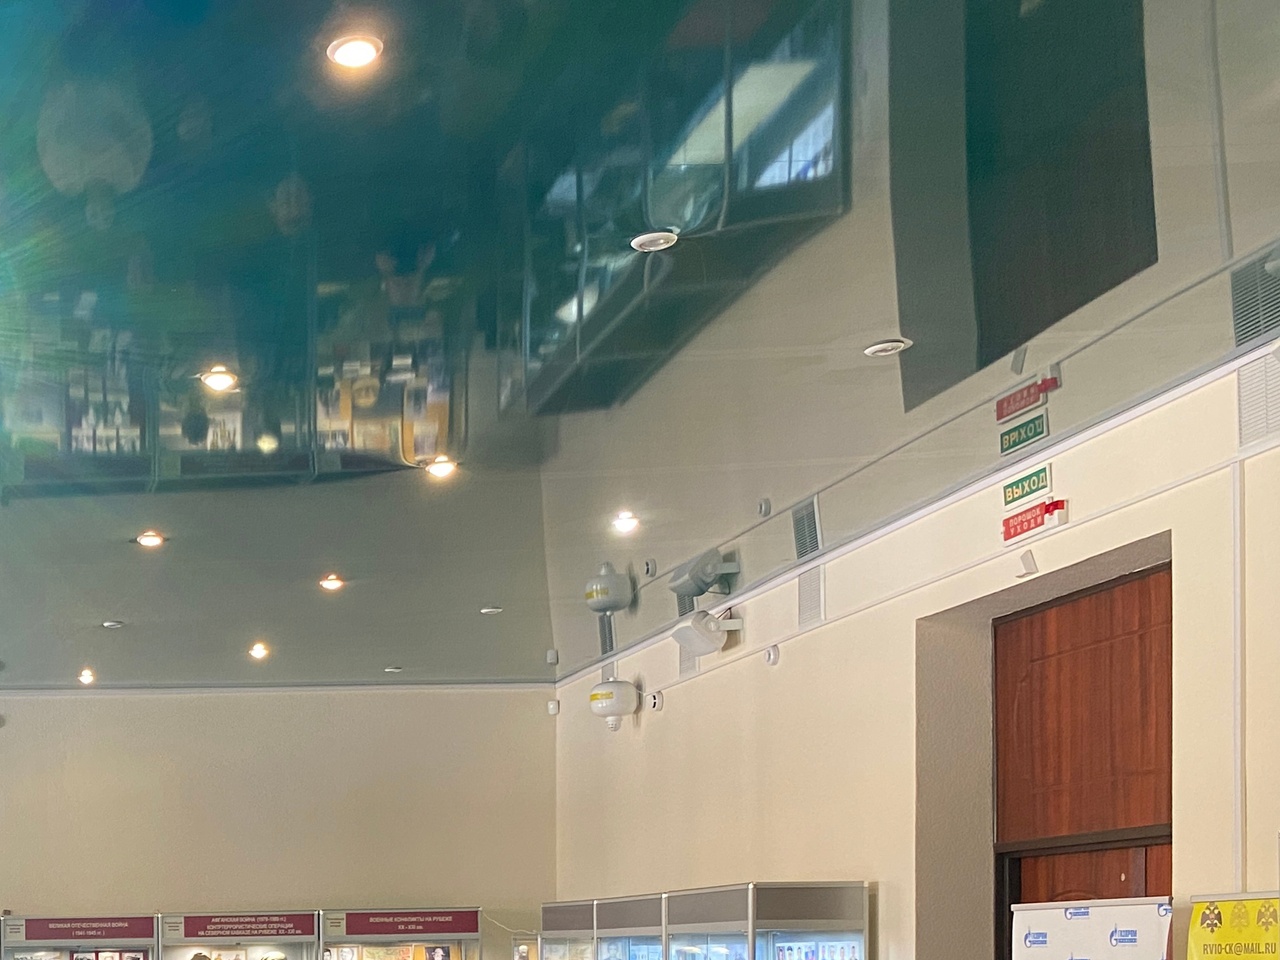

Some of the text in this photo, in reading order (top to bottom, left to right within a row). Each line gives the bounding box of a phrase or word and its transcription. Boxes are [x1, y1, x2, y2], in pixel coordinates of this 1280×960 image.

[1005, 472, 1047, 501] ВЫХОД
[1009, 507, 1041, 527] ПОРОШОК
[1010, 514, 1043, 535] УХОДИ
[1203, 942, 1277, 956] RVIO-CK@MAIL.RU
